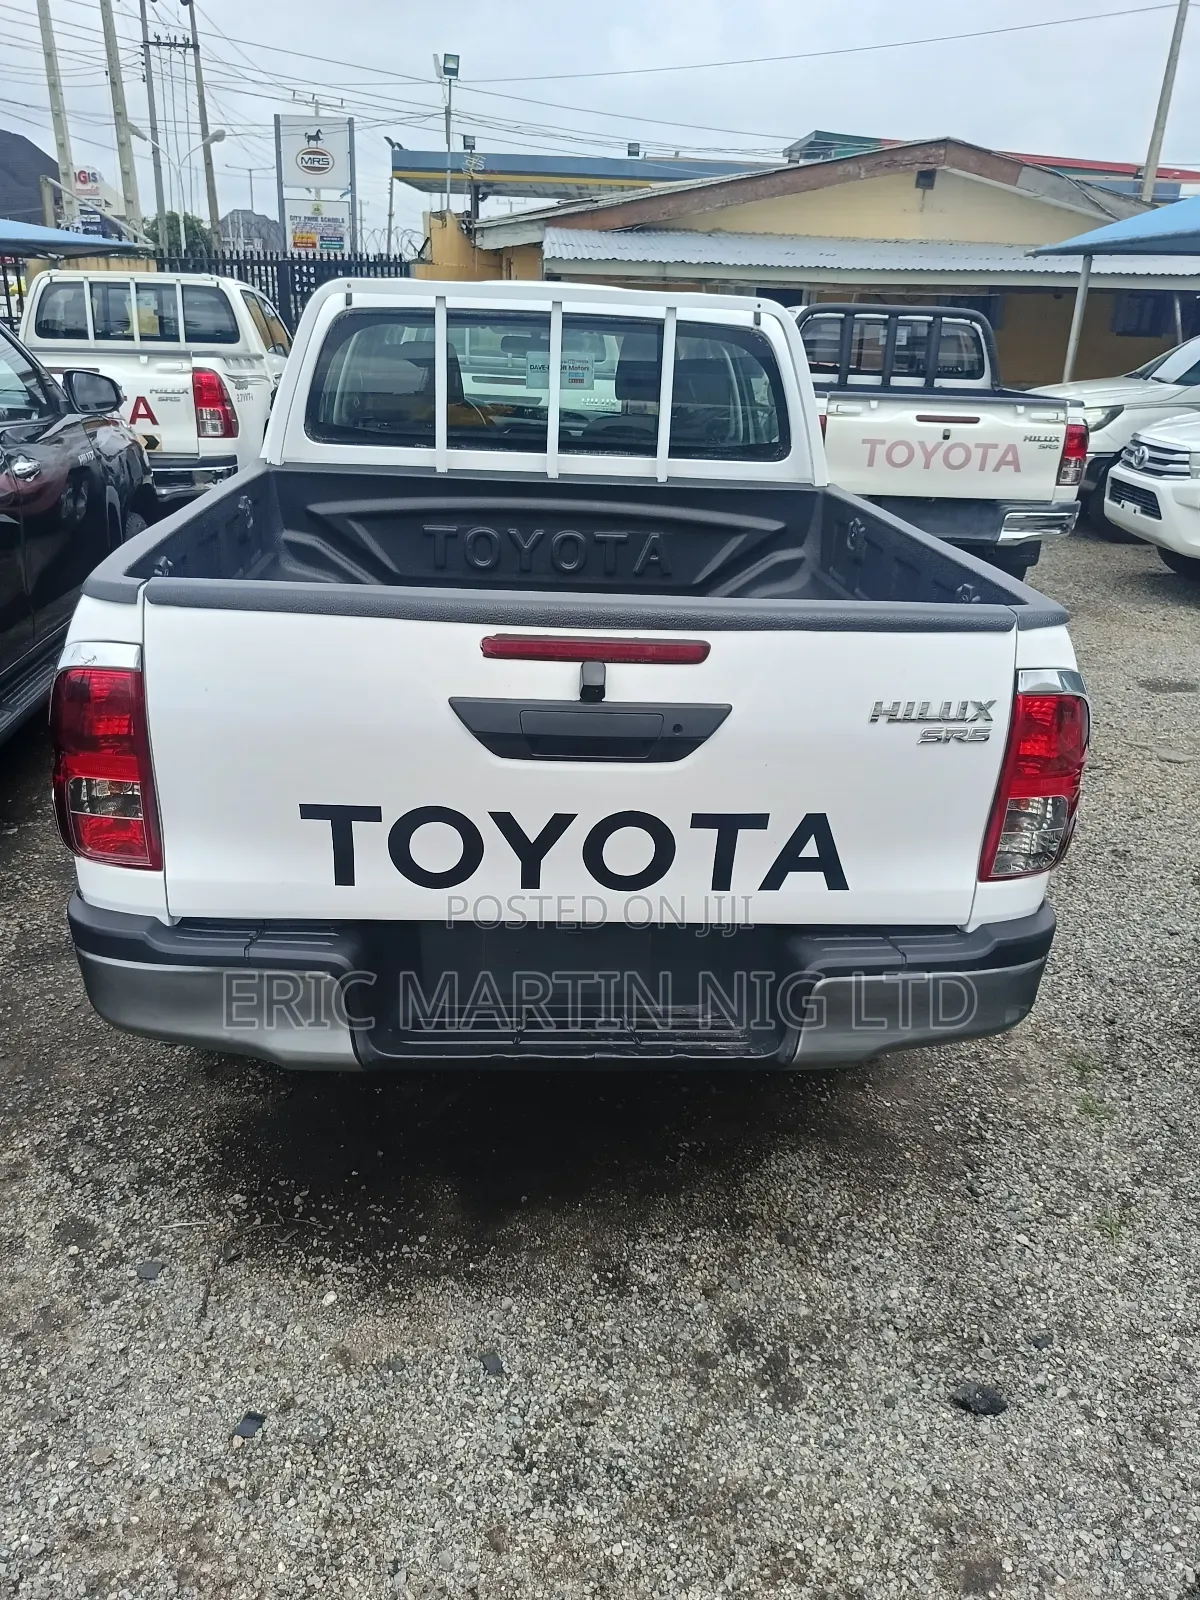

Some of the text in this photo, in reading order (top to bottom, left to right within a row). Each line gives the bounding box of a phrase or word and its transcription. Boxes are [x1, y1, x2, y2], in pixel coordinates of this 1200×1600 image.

[300, 156, 330, 166] MRS
[861, 438, 1021, 473] TOYOTA
[423, 524, 672, 577] TOYOTA
[869, 699, 996, 723] HILUX
[917, 727, 992, 744] SR5
[300, 803, 849, 891] TOYOTA
